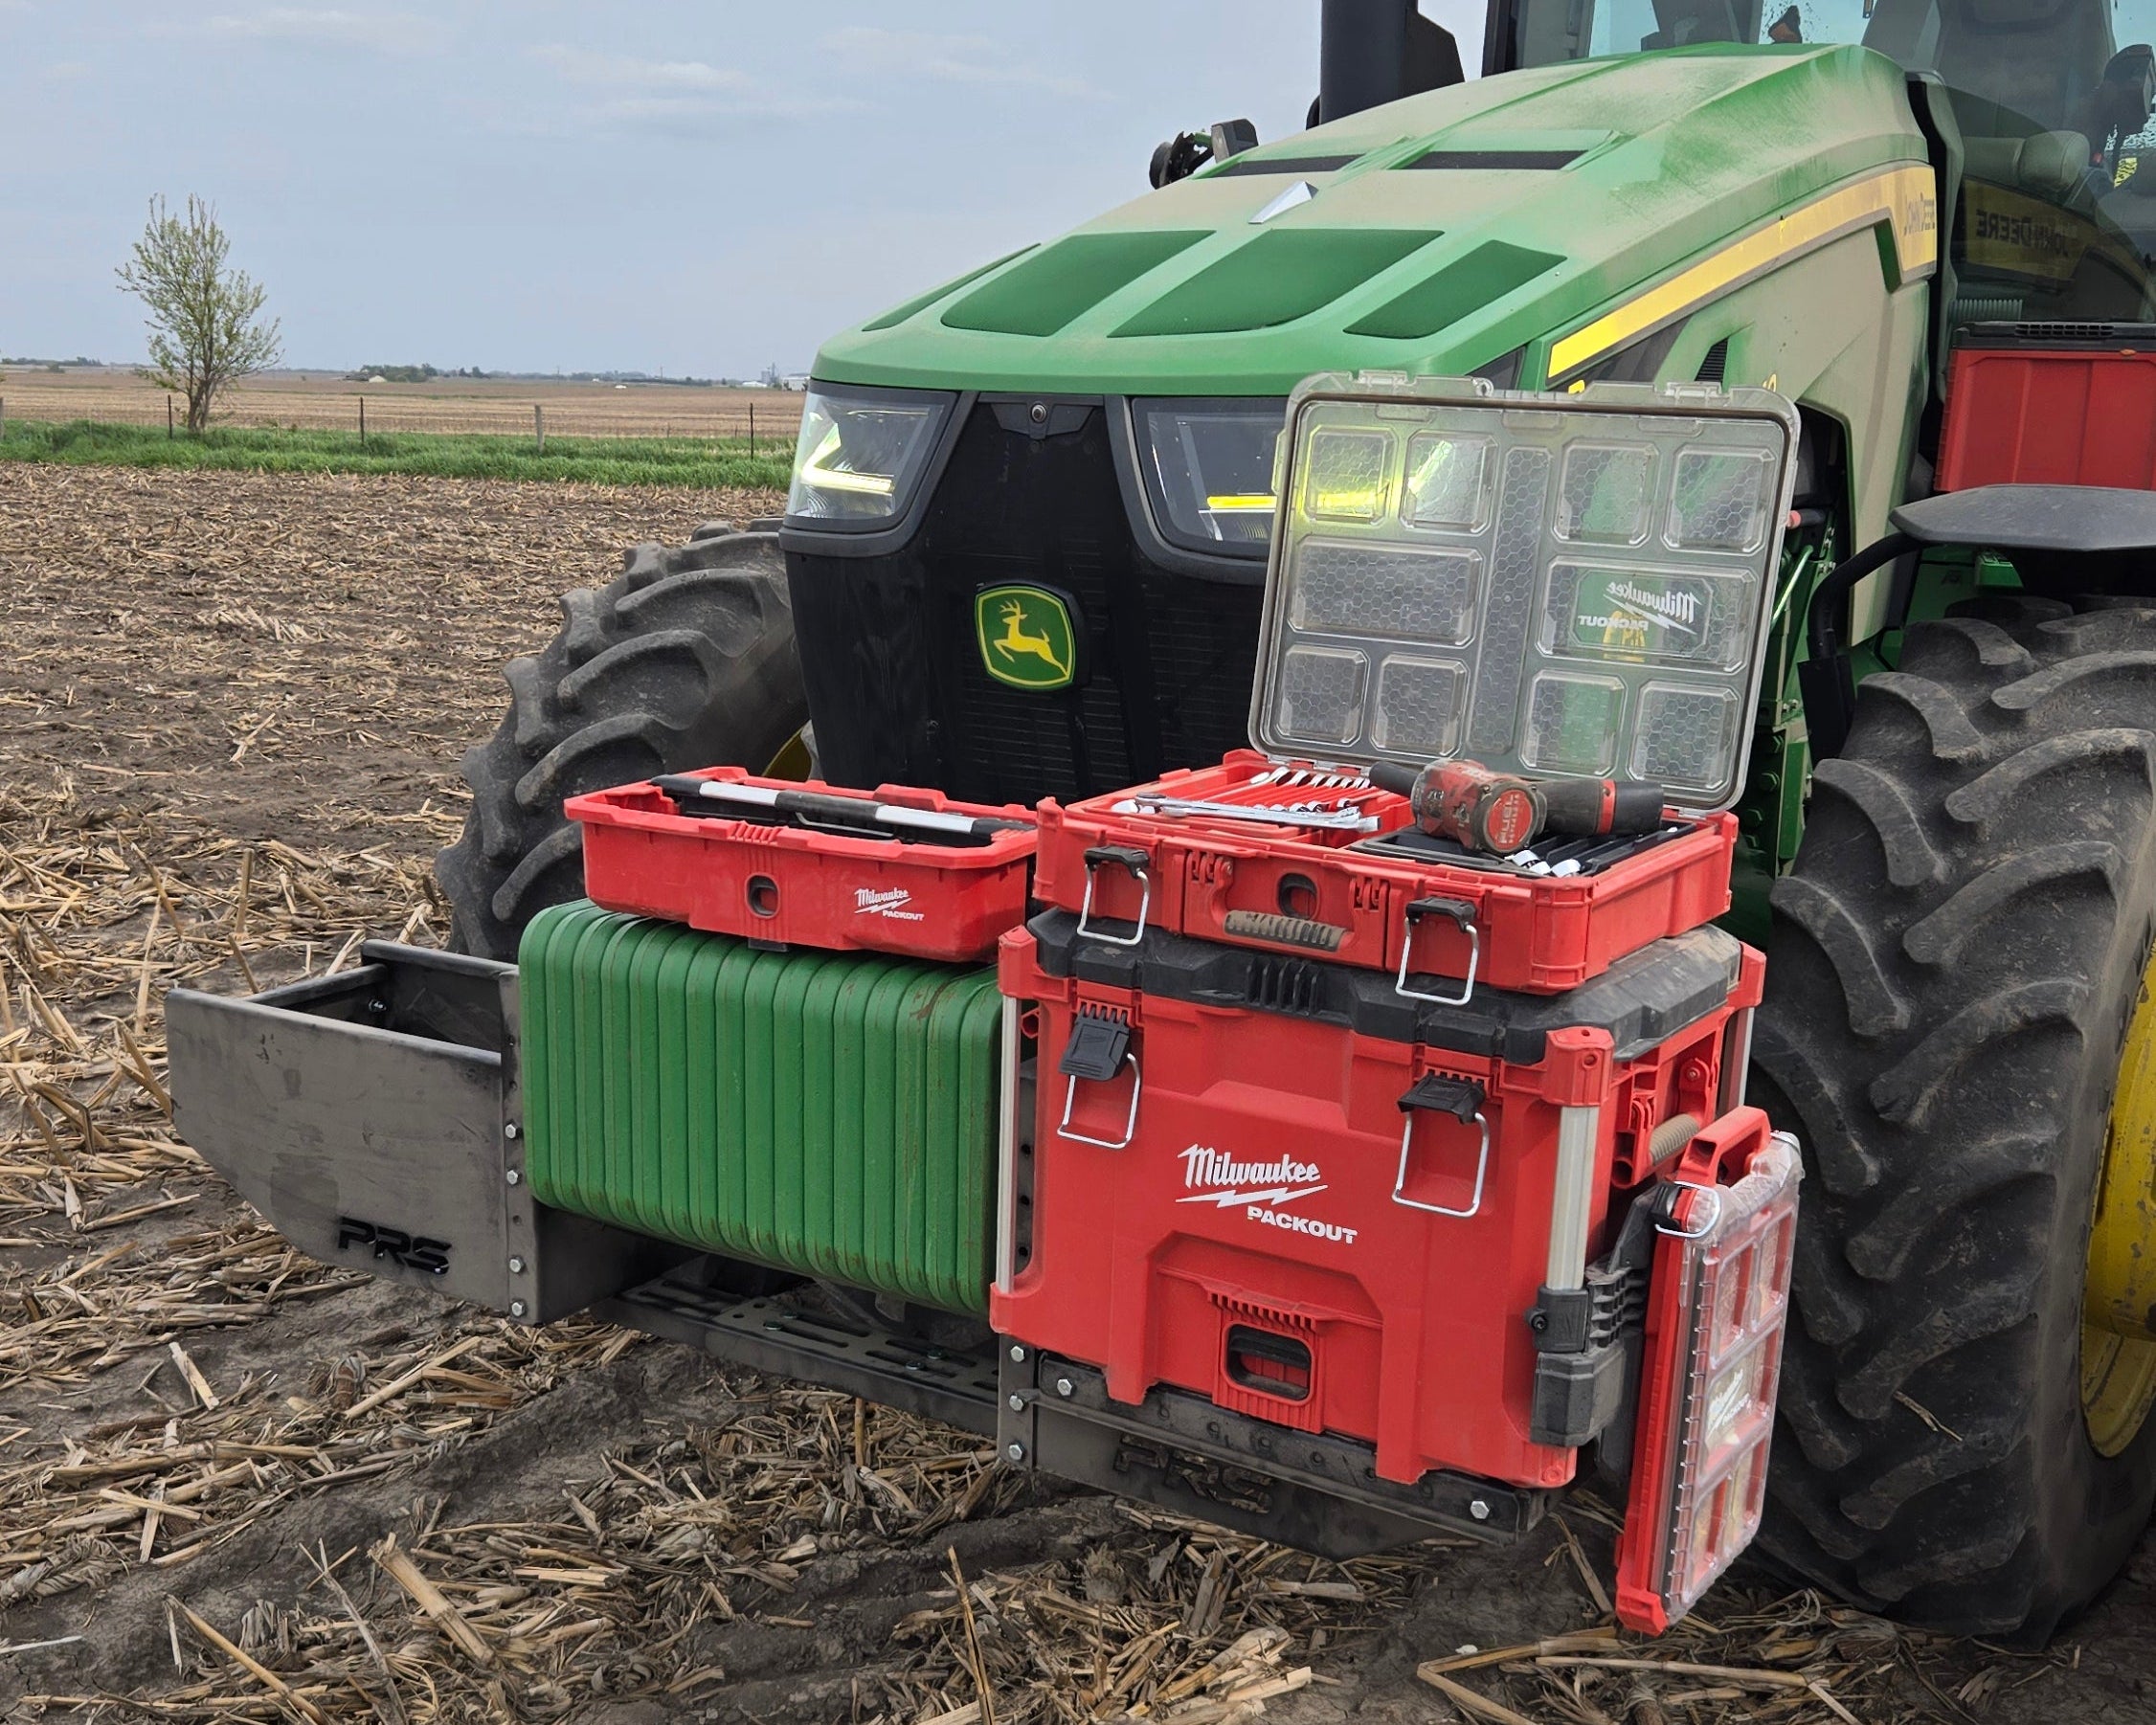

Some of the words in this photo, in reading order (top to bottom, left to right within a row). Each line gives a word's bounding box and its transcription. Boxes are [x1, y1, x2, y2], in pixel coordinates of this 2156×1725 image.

[854, 886, 910, 907] Milwaukee
[882, 909, 925, 921] PACKOUT
[1178, 1143, 1321, 1189] Milwaukee
[1247, 1205, 1358, 1243] PACKOUT
[338, 1216, 452, 1275] PRS
